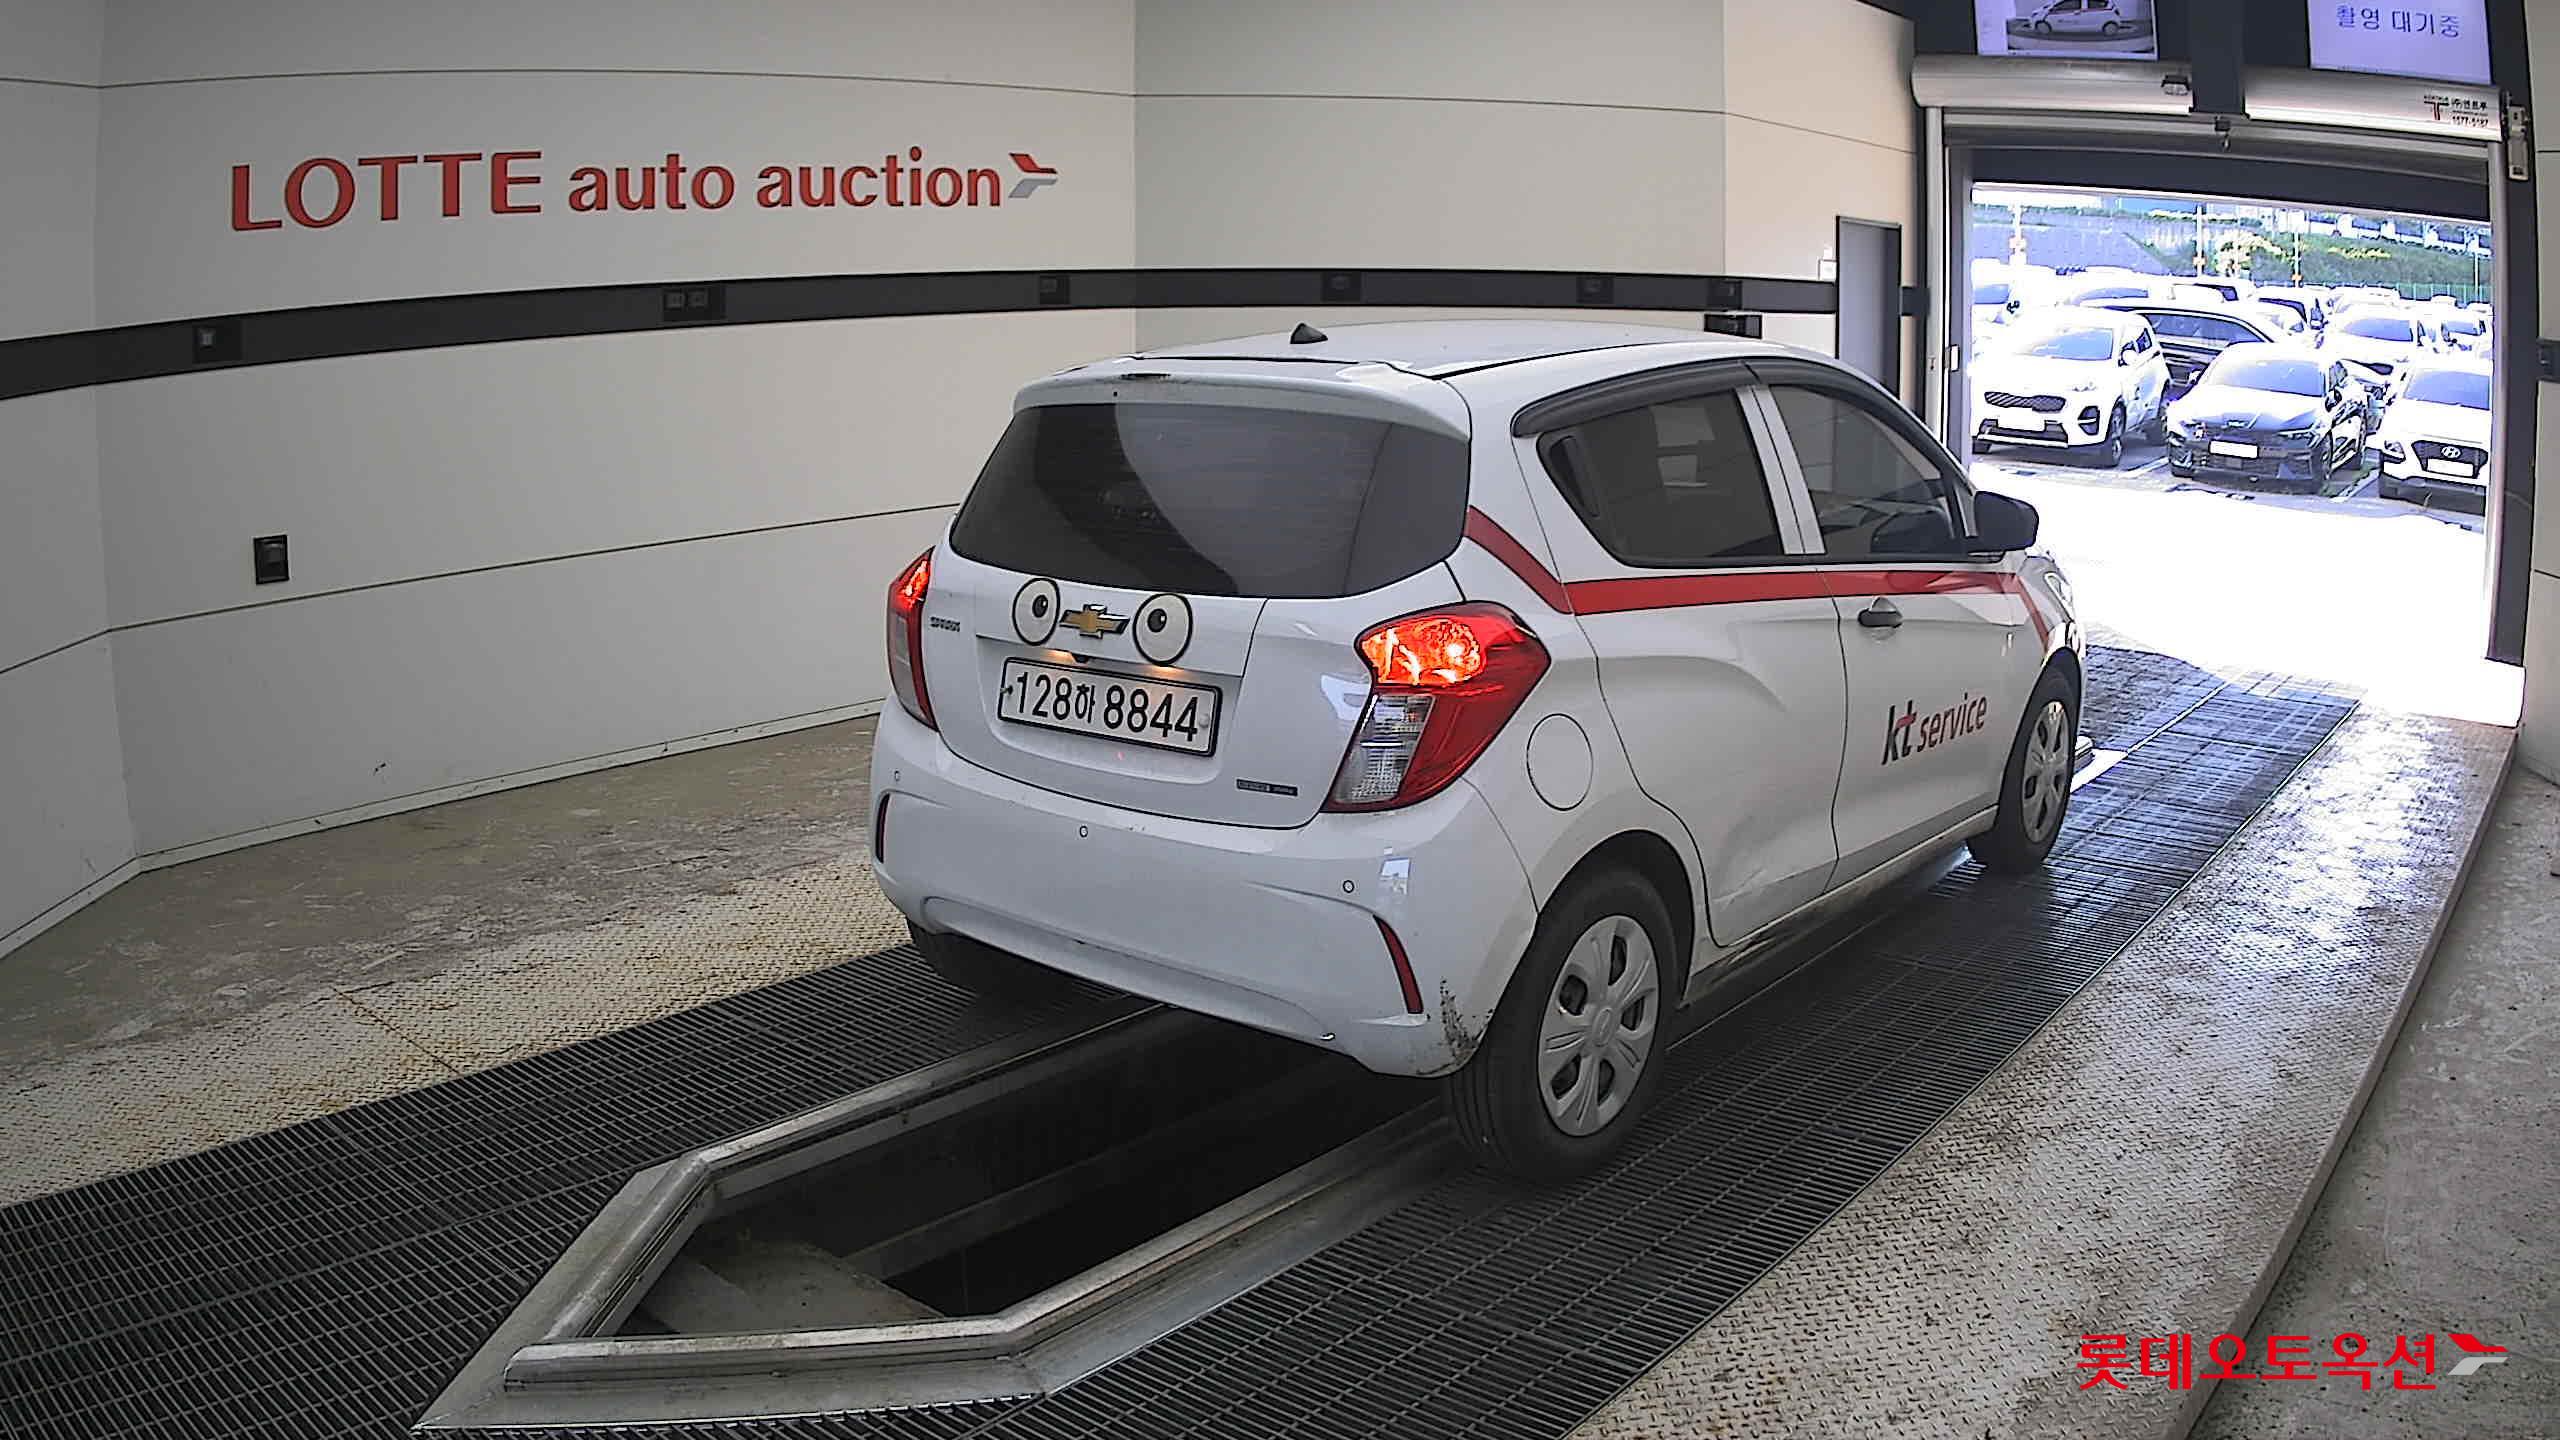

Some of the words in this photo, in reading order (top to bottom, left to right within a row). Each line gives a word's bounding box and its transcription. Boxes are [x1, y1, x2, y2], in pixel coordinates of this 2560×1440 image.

[2391, 10, 2459, 38] 대기중
[231, 151, 542, 231] LOTTE
[568, 153, 735, 212] auto
[756, 147, 1001, 208] auction
[1016, 671, 1096, 724] 128하
[1103, 684, 1199, 742] 8844
[1881, 699, 1918, 766] kt
[1917, 691, 1987, 753] service
